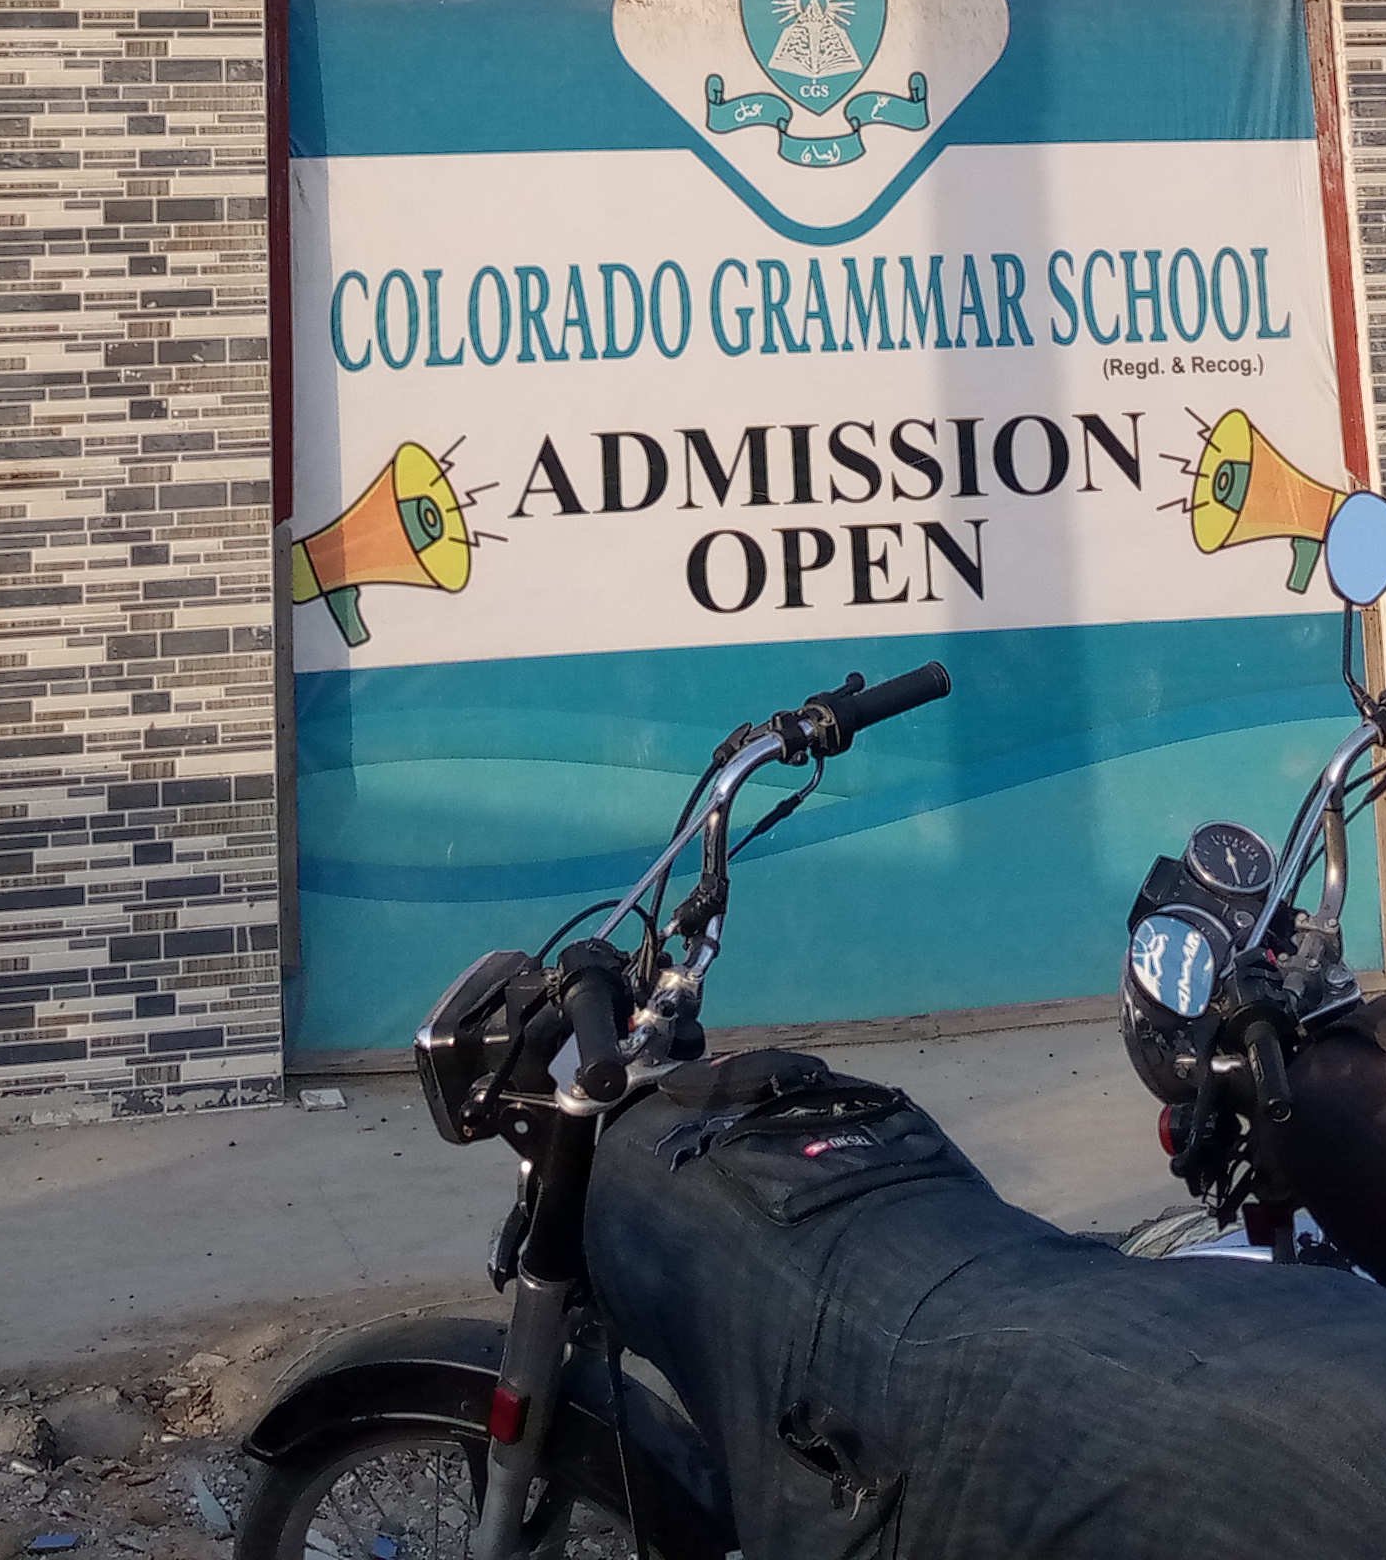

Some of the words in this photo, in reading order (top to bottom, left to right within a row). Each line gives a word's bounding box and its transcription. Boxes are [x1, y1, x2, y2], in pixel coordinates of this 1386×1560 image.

[800, 85, 830, 98] CGS
[331, 260, 692, 372] COLORADO
[709, 252, 1035, 357] GRAMMAR
[1047, 247, 1291, 345] SCHOOL
[1103, 357, 1165, 381] (Regd.
[1171, 356, 1186, 374] &
[1191, 354, 1264, 377] Recog.)
[508, 411, 1146, 519] ADMISSION
[686, 518, 990, 614] OPEN
